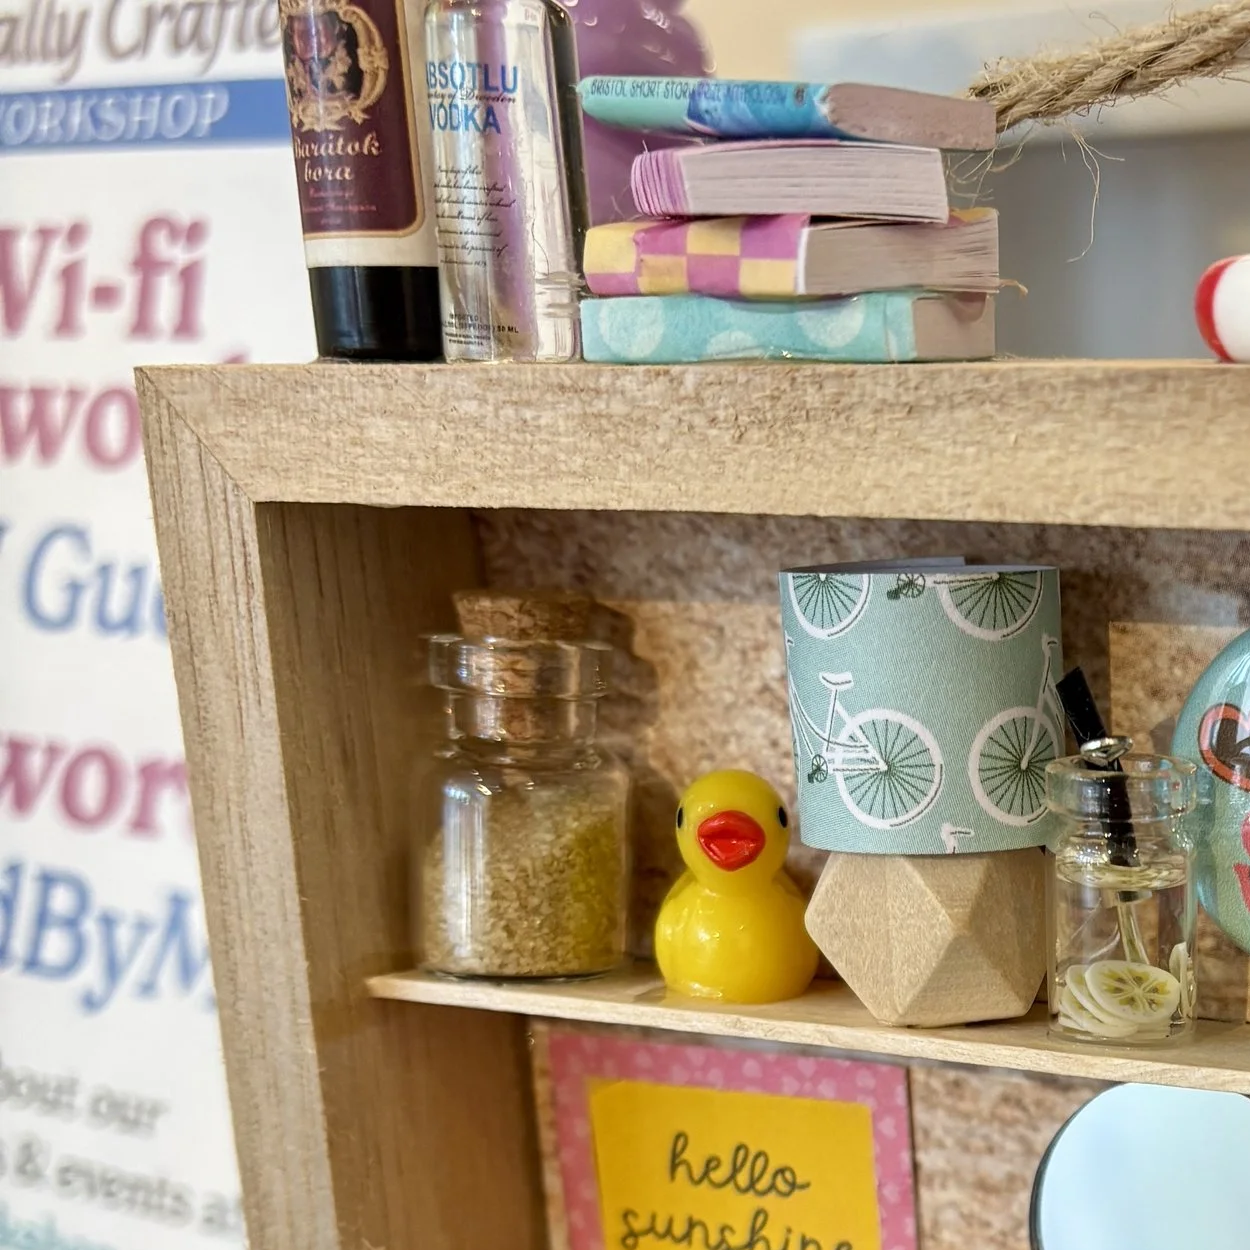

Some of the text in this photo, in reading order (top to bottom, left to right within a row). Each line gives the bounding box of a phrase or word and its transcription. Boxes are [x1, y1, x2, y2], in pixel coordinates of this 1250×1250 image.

[590, 79, 627, 97] BRISTOL
[630, 80, 662, 99] SHORT
[429, 103, 502, 134] VODKA
[669, 1130, 811, 1198] hello
